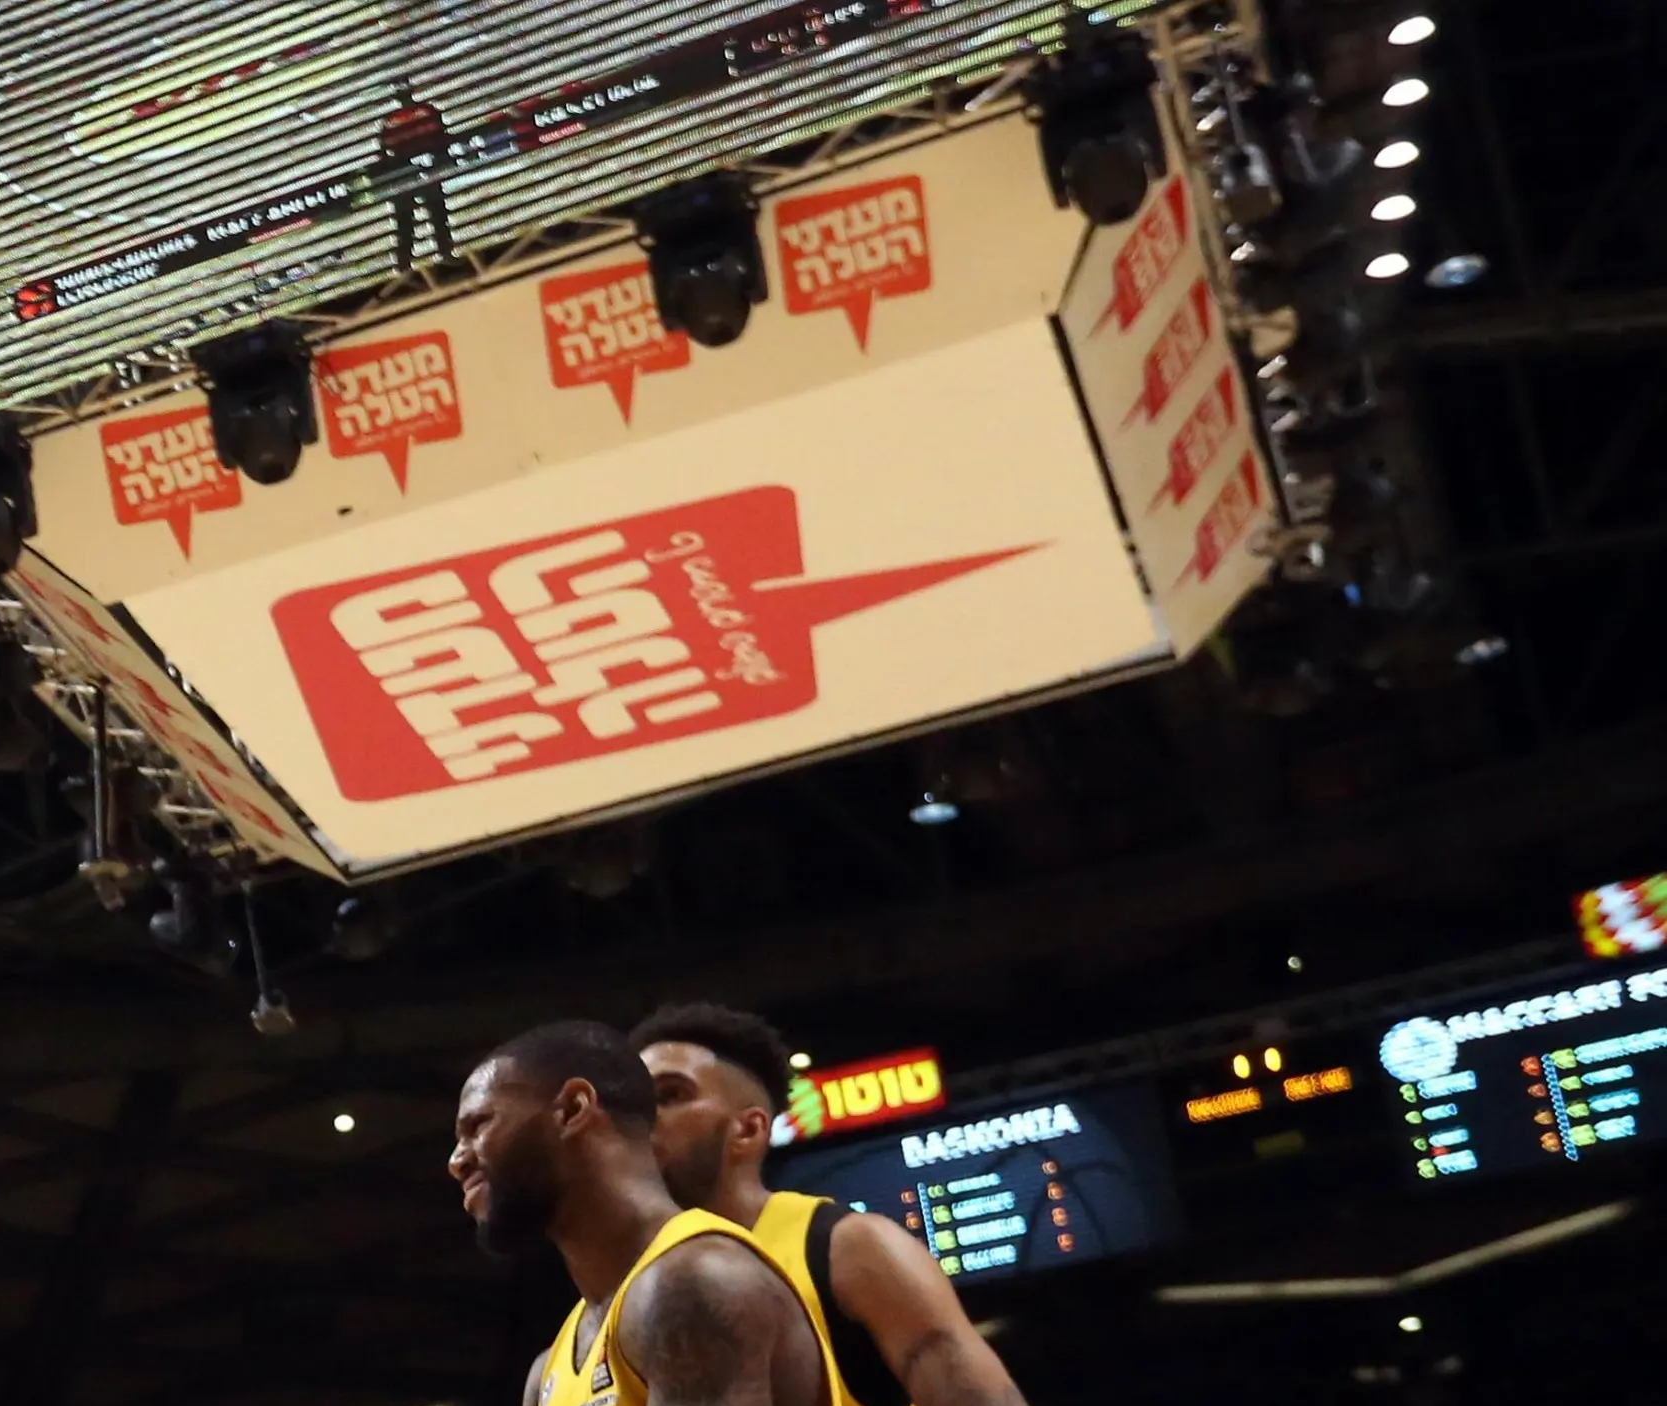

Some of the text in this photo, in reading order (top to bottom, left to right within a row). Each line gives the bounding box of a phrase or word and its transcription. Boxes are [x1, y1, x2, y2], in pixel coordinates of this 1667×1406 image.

[781, 188, 918, 250] מעדני
[793, 227, 923, 293] הטלה
[545, 275, 652, 327] עדני
[325, 342, 448, 400] מעדני
[335, 377, 454, 438] הטלה
[488, 529, 722, 739] הטלה
[329, 569, 563, 782] מעדני
